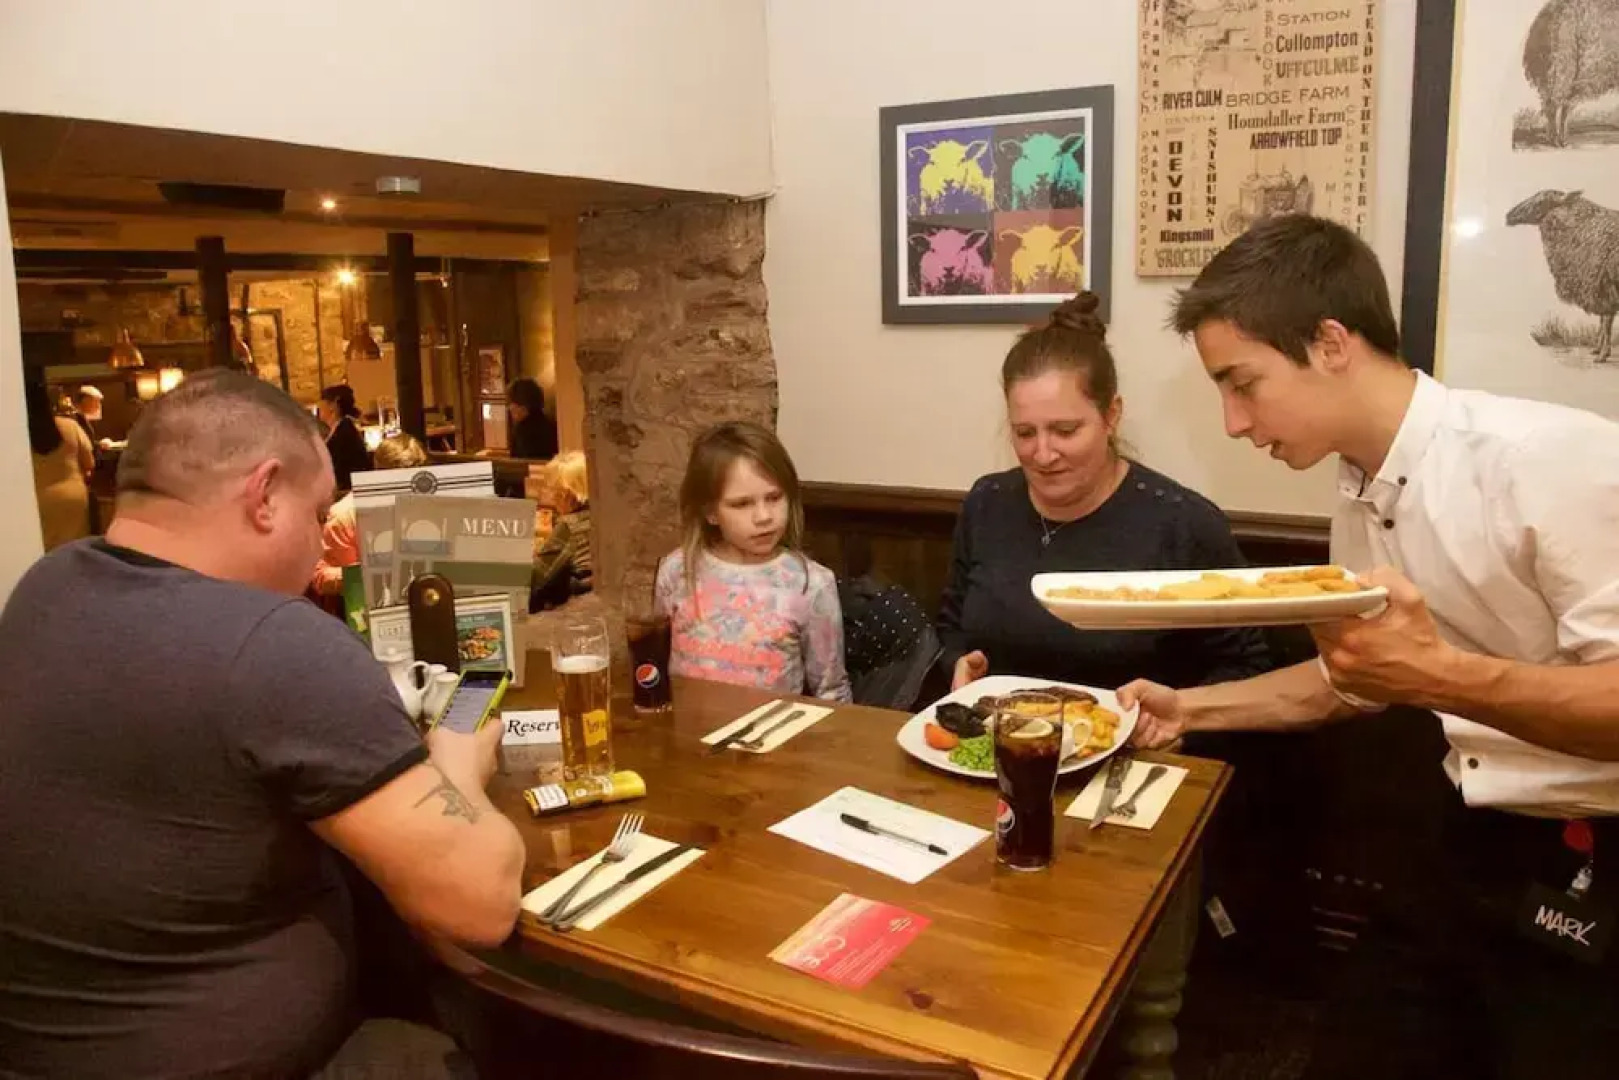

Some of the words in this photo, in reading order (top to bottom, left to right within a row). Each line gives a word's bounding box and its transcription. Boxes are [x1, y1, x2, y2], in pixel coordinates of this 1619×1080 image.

[1277, 9, 1351, 26] STATION
[1275, 31, 1359, 53] Cullompton
[1163, 92, 1193, 110] RIVER
[1195, 89, 1223, 108] CULM
[1226, 90, 1292, 107] BRIDGE
[1299, 86, 1350, 102] FARM
[1308, 108, 1346, 124] Farm
[1321, 128, 1342, 146] TOP
[1167, 141, 1183, 222] DEVON
[462, 517, 527, 537] MENU
[1535, 904, 1597, 946] MARK
